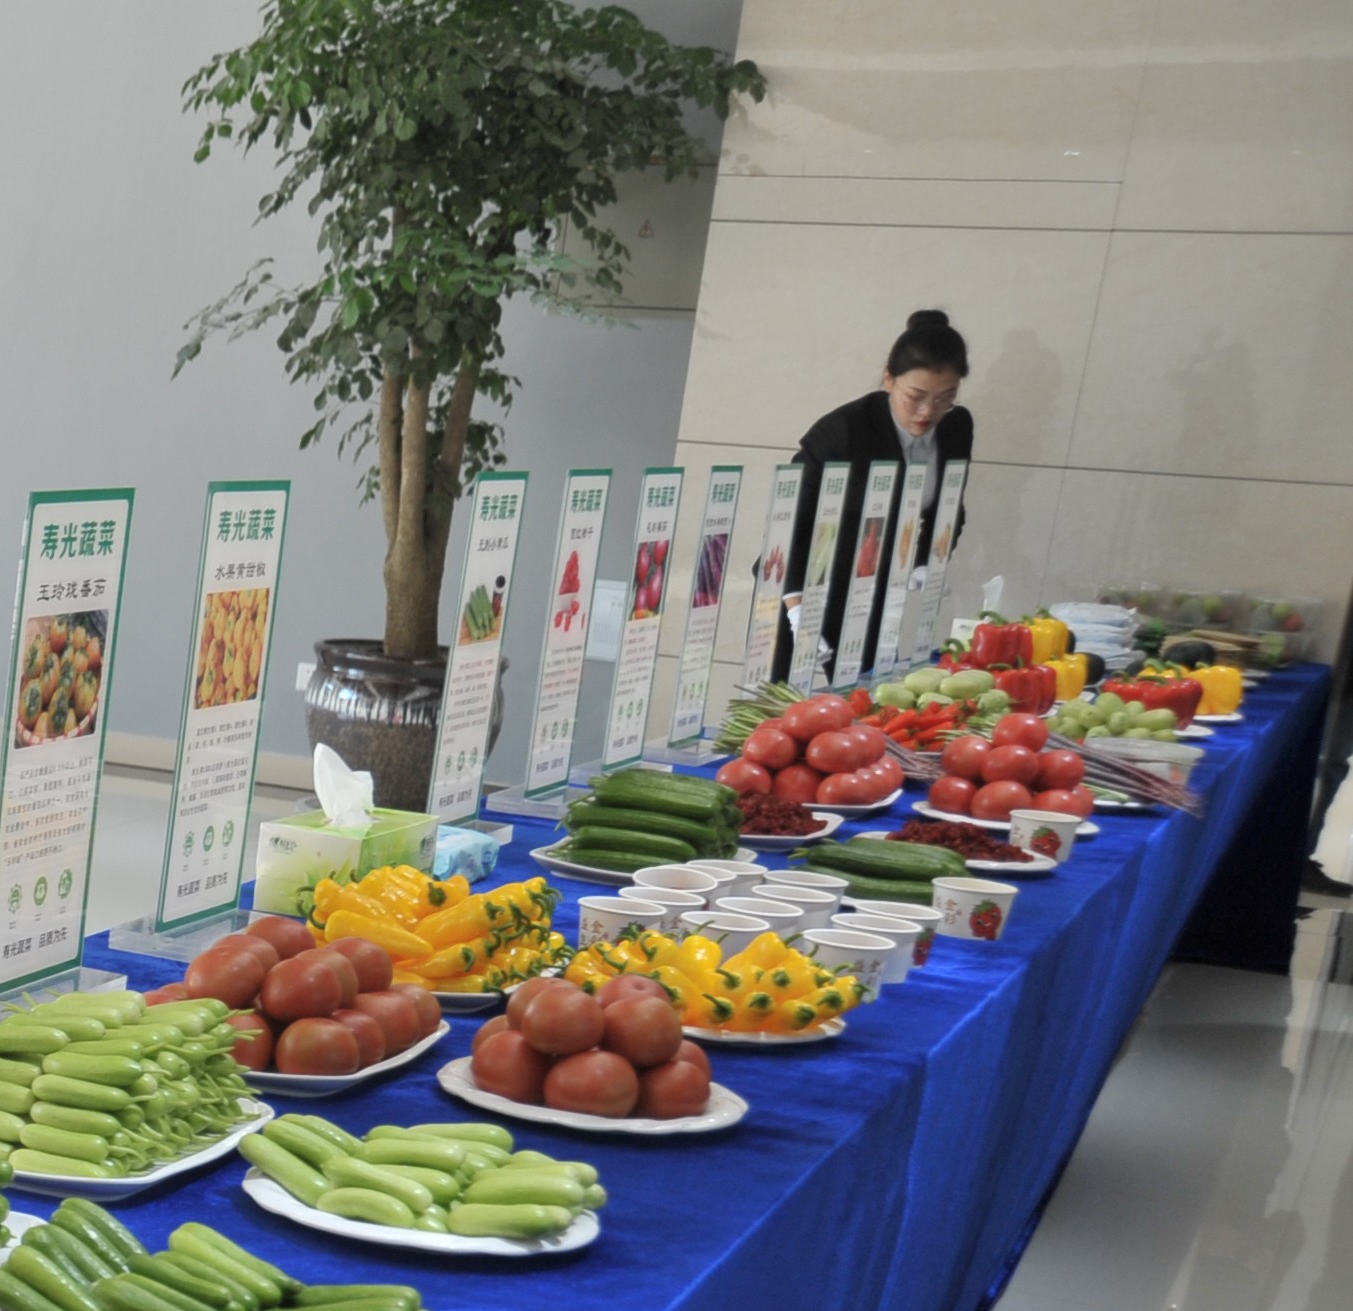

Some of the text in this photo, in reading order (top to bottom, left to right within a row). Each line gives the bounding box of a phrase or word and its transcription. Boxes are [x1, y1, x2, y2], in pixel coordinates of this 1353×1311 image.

[217, 508, 277, 542] 寿光蔬菜
[479, 494, 518, 522] 寿光蔬菜
[40, 520, 116, 560] 寿光蔬菜
